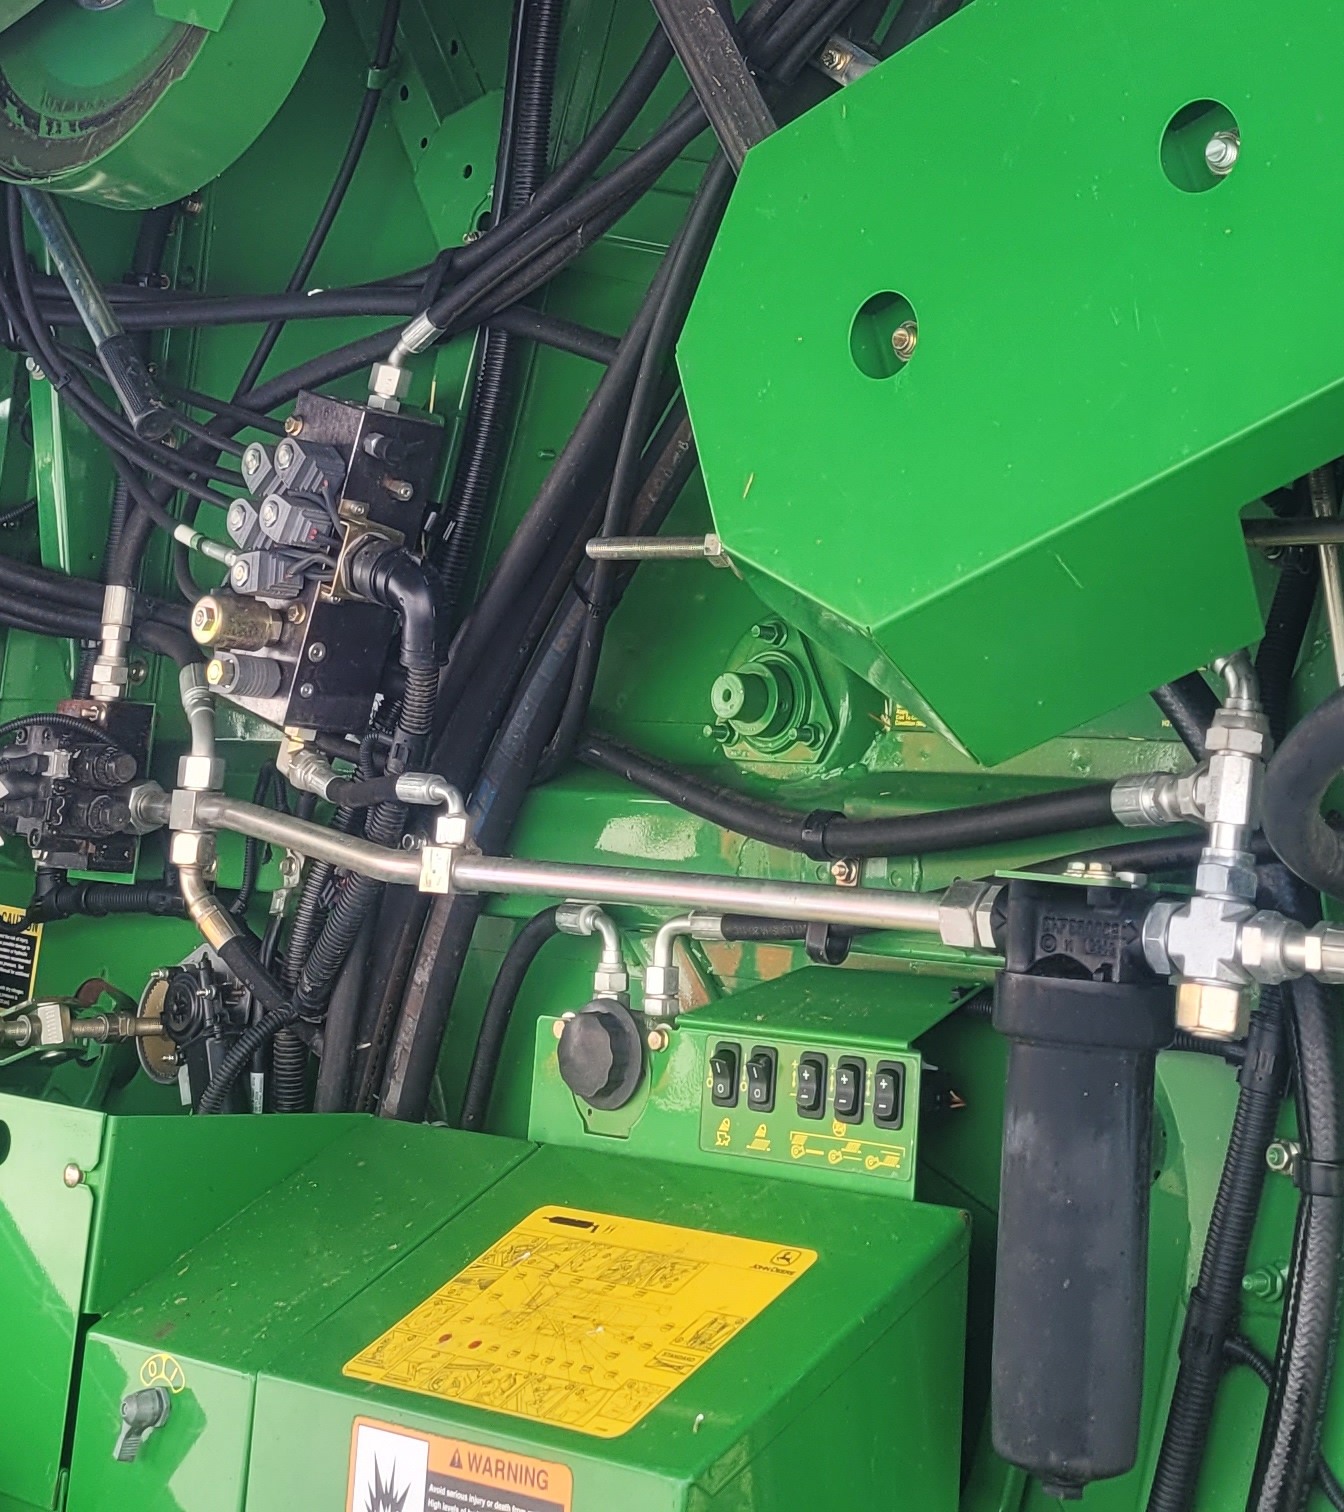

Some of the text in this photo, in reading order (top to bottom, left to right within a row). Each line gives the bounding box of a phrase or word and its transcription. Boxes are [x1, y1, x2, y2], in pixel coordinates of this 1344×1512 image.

[467, 1451, 549, 1490] WARNING
[427, 1498, 442, 1510] High
[429, 1483, 446, 1495] Avoid
[446, 1489, 468, 1501] serious
[468, 1493, 486, 1508] injury
[486, 1499, 494, 1508] or
[494, 1501, 511, 1512] death
